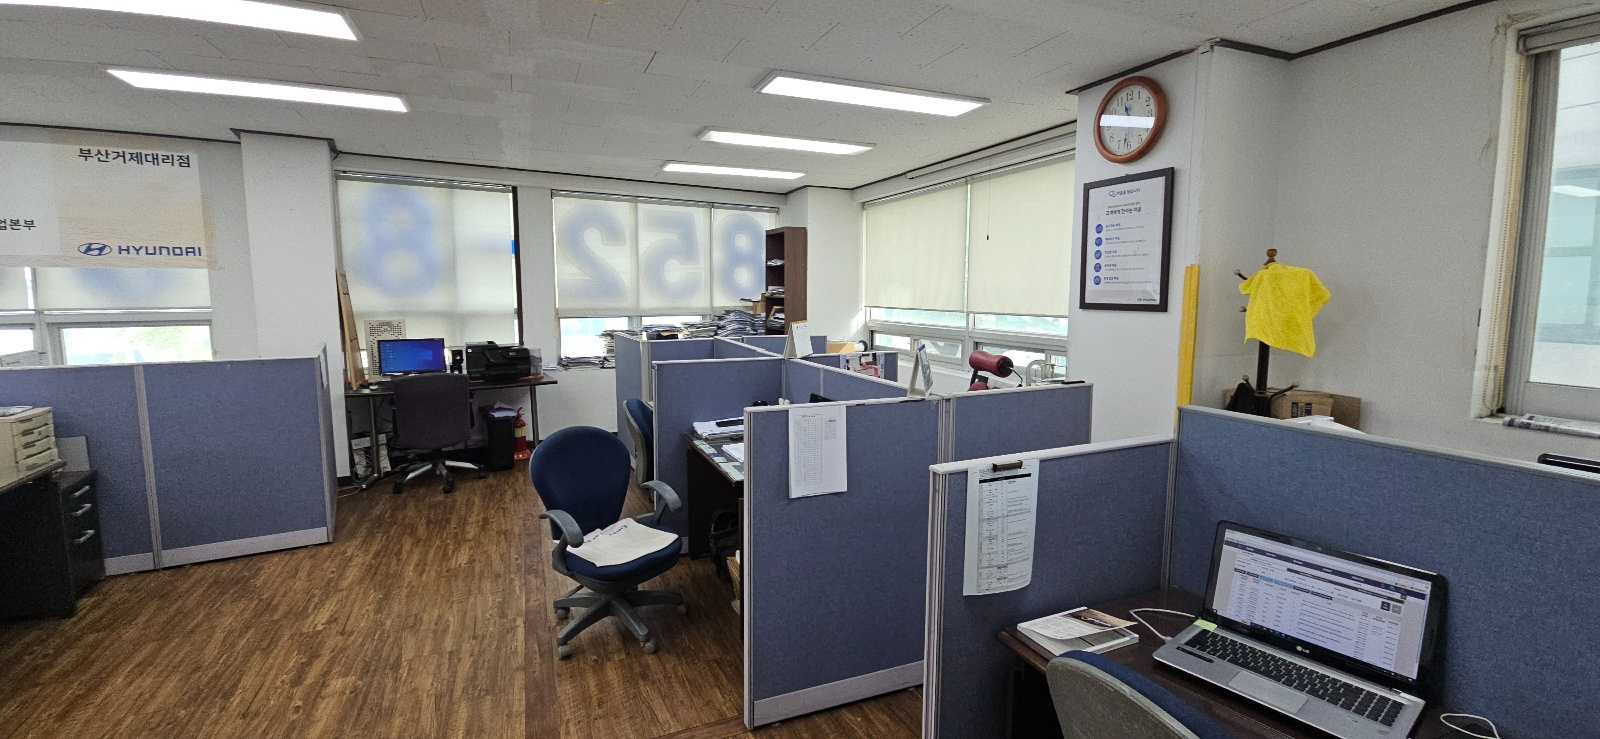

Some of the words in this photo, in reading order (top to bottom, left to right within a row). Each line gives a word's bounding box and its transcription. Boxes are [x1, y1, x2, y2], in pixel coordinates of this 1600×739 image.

[1126, 90, 1134, 101] 12
[1116, 96, 1123, 107] 11
[1145, 96, 1151, 107] 2
[1109, 132, 1115, 142] 8
[1137, 134, 1143, 144] 5
[77, 148, 191, 168] 부산거제대리점
[117, 245, 202, 257] HYUNDAI
